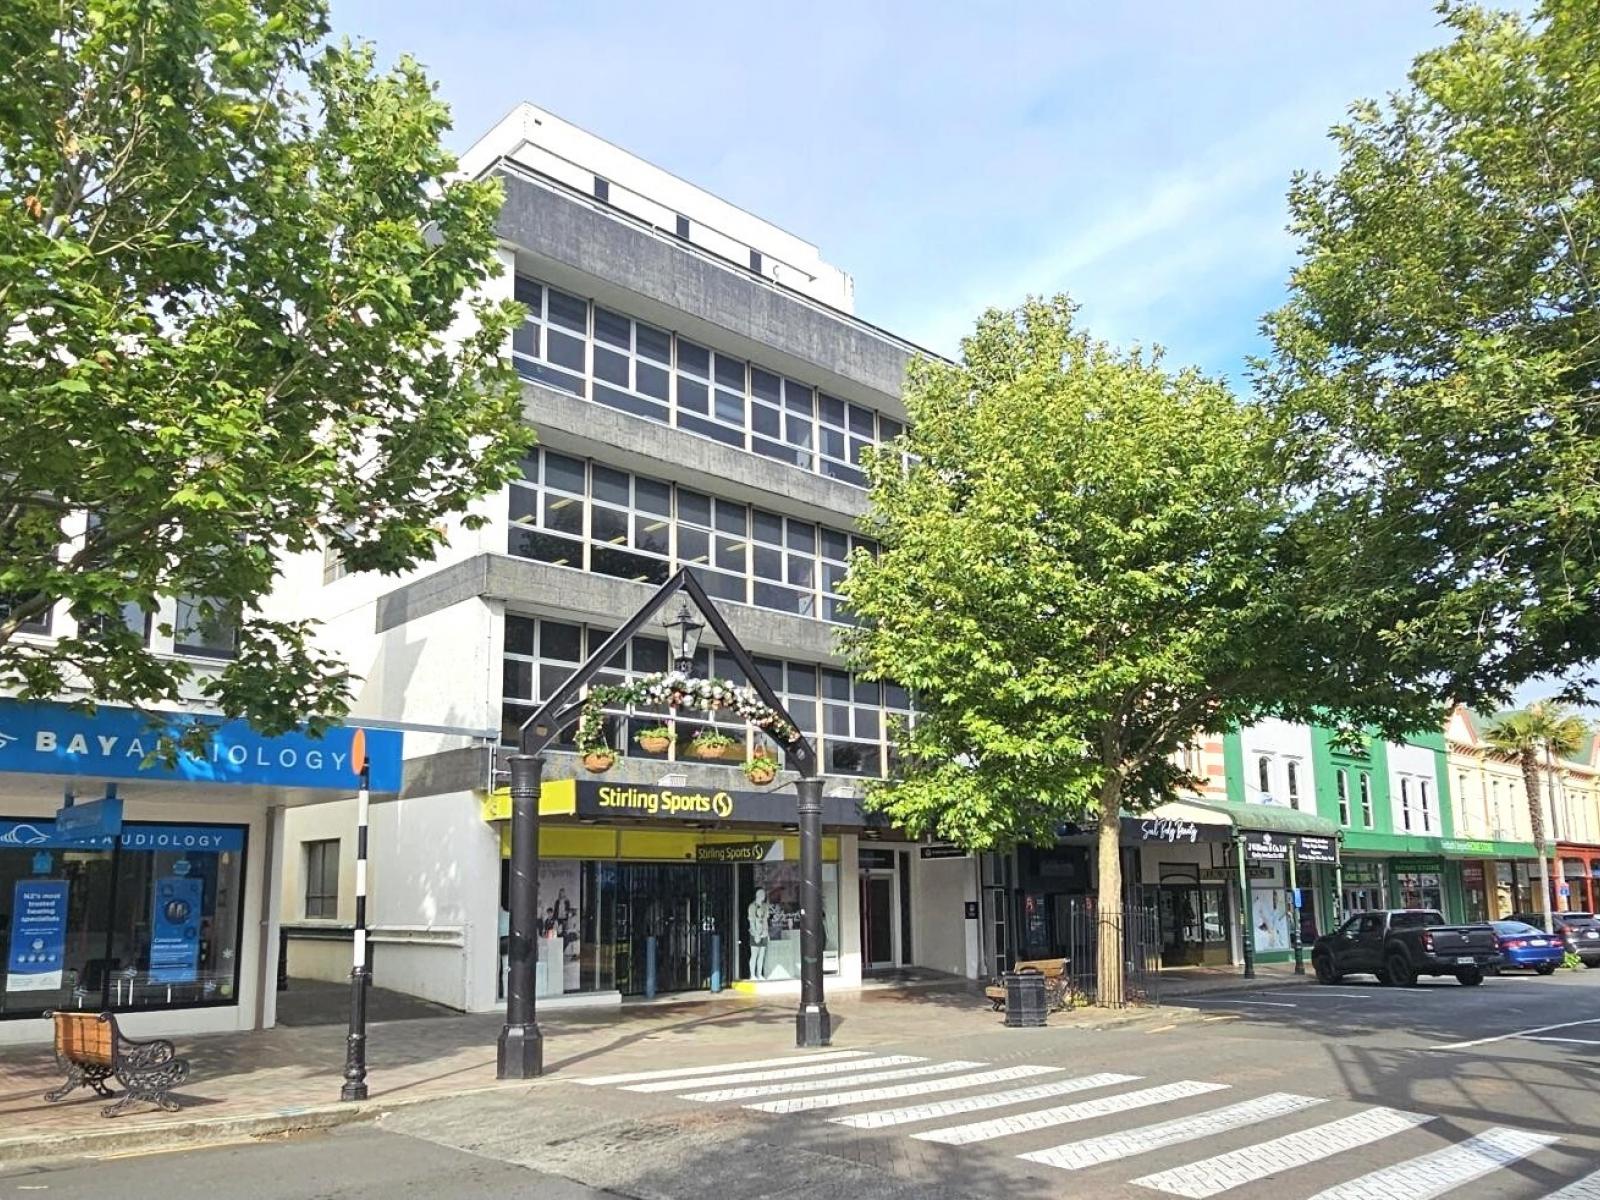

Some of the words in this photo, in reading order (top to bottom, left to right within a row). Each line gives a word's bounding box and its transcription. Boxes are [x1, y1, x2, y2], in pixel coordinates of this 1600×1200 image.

[599, 787, 658, 813] Stirling
[661, 791, 711, 814] Sports
[699, 847, 725, 860] Stirling
[726, 846, 751, 860] Sports
